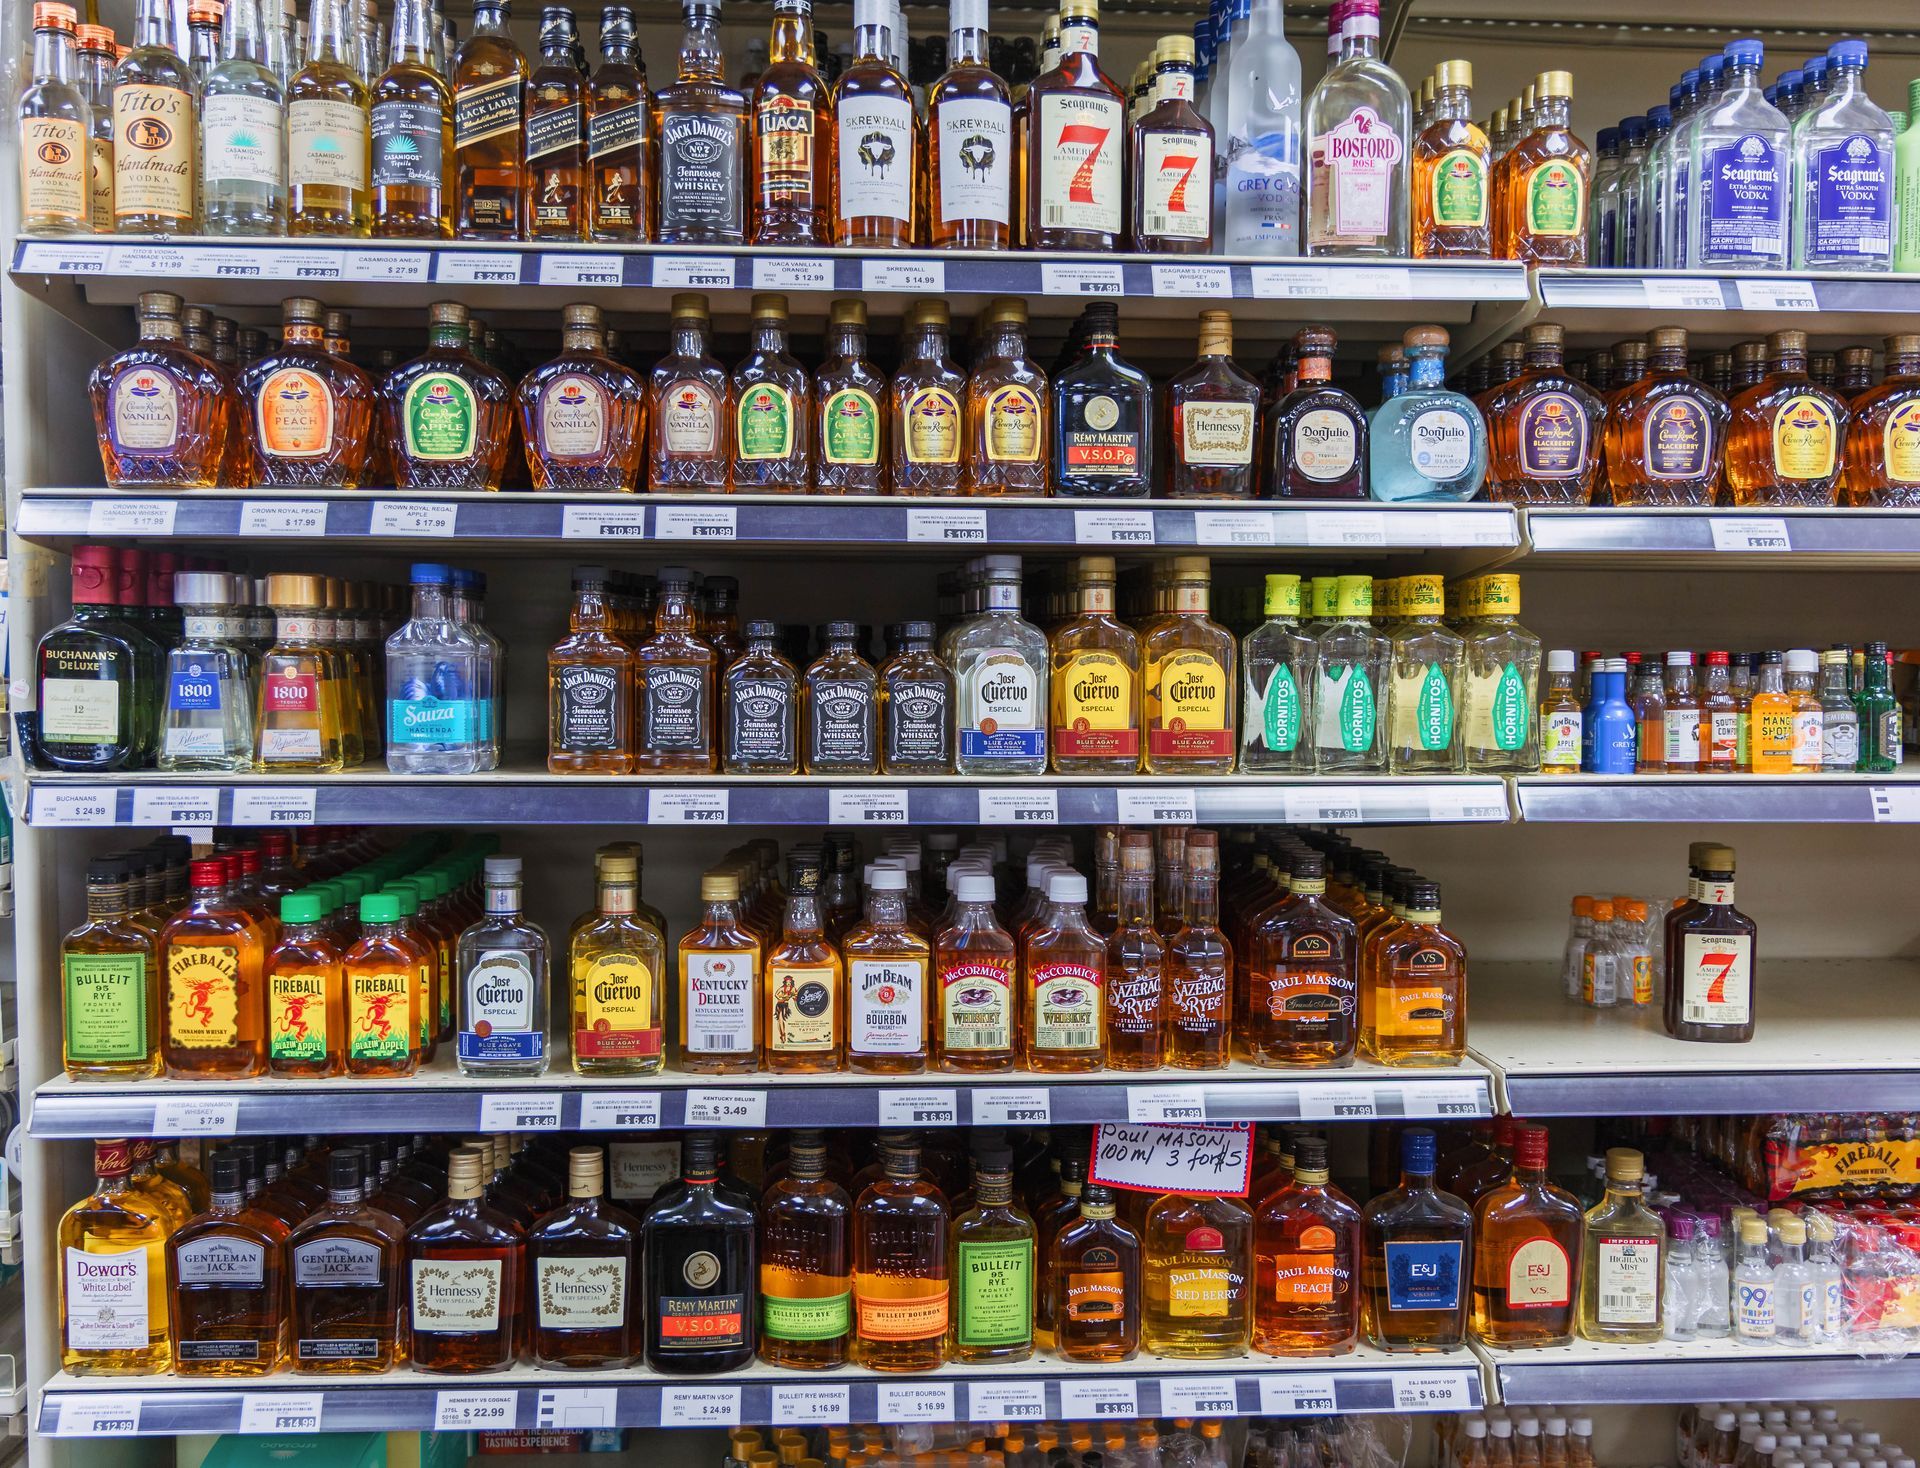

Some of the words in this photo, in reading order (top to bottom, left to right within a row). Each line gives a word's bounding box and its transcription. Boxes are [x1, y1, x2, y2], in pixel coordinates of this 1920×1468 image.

[121, 90, 180, 114] Tito's
[455, 104, 485, 122] BLACK
[487, 95, 520, 113] LABEL
[1061, 98, 1109, 115] Seagram's
[528, 125, 552, 138] BLACK
[554, 118, 577, 130] LABEL
[760, 113, 808, 132] TUACA
[846, 116, 906, 130] SKREWBALL
[947, 119, 1006, 134] SKREWBALL
[33, 123, 77, 140] Tito's
[666, 127, 692, 144] JACK
[692, 123, 734, 147] DANIEL'S
[1162, 136, 1197, 147] Seagram's
[1332, 138, 1394, 160] BOSFORD
[117, 158, 188, 176] Handmade
[1058, 123, 1111, 204] 7
[29, 167, 82, 182] Handmade
[129, 174, 169, 184] VODKA
[677, 166, 722, 178] Tennessee
[1722, 165, 1779, 182] Seagram's
[1828, 166, 1885, 182] Seagram's
[674, 182, 725, 191] WHISKEY
[1161, 155, 1198, 212] 7
[1238, 178, 1272, 192] GREY
[1734, 189, 1769, 200] VODKA
[1841, 190, 1875, 200] VODKA
[123, 413, 171, 421] VANILLA
[275, 417, 317, 425] PEACH
[551, 420, 597, 428] VANILLA
[419, 423, 465, 431] APPLE
[913, 422, 932, 432] Crown
[932, 421, 954, 432] Royal
[1197, 421, 1242, 434] Hennessy
[1099, 433, 1132, 443] MARTIN
[46, 650, 117, 661] BUCHANAN'S
[564, 673, 582, 690] JACK
[583, 671, 617, 690] DANIEL'S
[997, 672, 1016, 686] Jose
[1088, 672, 1107, 684] Jose
[179, 685, 212, 698] 1800
[273, 687, 308, 699] 1800
[817, 688, 836, 704] JACK
[836, 685, 869, 705] DANIEL'S
[982, 679, 1027, 703] Cuervo
[1074, 679, 1119, 702] Cuervo
[404, 705, 454, 725] Sauza
[572, 706, 606, 715] Tennessee
[1277, 680, 1289, 748] HORNITOS
[1352, 679, 1364, 748] HORNITOS
[1551, 719, 1564, 729] JIM
[1564, 718, 1580, 728] BEAM
[1304, 940, 1319, 949] VS
[1701, 936, 1737, 945] Seagram's
[172, 953, 233, 976] FIREBALL
[77, 975, 131, 987] BULLEIT
[862, 971, 882, 991] JIM
[883, 969, 912, 991] BEAM
[945, 969, 1008, 983] McCORMICK
[1037, 966, 1098, 982] McCORMICK
[1700, 953, 1737, 1002] 7
[273, 979, 322, 996] FIREBALL
[692, 978, 748, 992] KENTUCKY
[1173, 976, 1225, 1004] SAZERAC
[1269, 977, 1302, 992] PAUL
[1305, 974, 1355, 991] MASSON
[93, 992, 112, 1000] RYE
[698, 992, 740, 1005] DELUXE
[866, 1015, 907, 1026] BOURBON
[723, 1106, 747, 1115] 3.49
[1102, 1123, 1149, 1142] Paul
[1101, 1143, 1127, 1161] 100
[1130, 1146, 1154, 1165] ml
[1167, 1150, 1179, 1166] 3
[1834, 1146, 1896, 1174] FIREBALL
[185, 1253, 257, 1263] GENTLEMAN
[1610, 1255, 1649, 1264] HIGHLAND
[78, 1261, 137, 1277] Dewar's
[207, 1263, 235, 1271] JACK
[972, 1260, 1022, 1273] BULLEIT
[1412, 1264, 1436, 1277] E&J
[1528, 1264, 1550, 1277] E&J
[1621, 1263, 1639, 1271] MIST
[1170, 1273, 1196, 1285] PAUL
[1198, 1269, 1244, 1284] MASSON
[429, 1284, 483, 1299] Hennessy
[555, 1282, 608, 1296] Hennessy
[1176, 1289, 1200, 1300] RED
[1202, 1289, 1239, 1300] BERRY
[1294, 1283, 1332, 1293] PEACH
[698, 1300, 736, 1312] MARTIN
[485, 1437, 518, 1449] TASTING
[520, 1435, 570, 1448] EXPERIENCE
